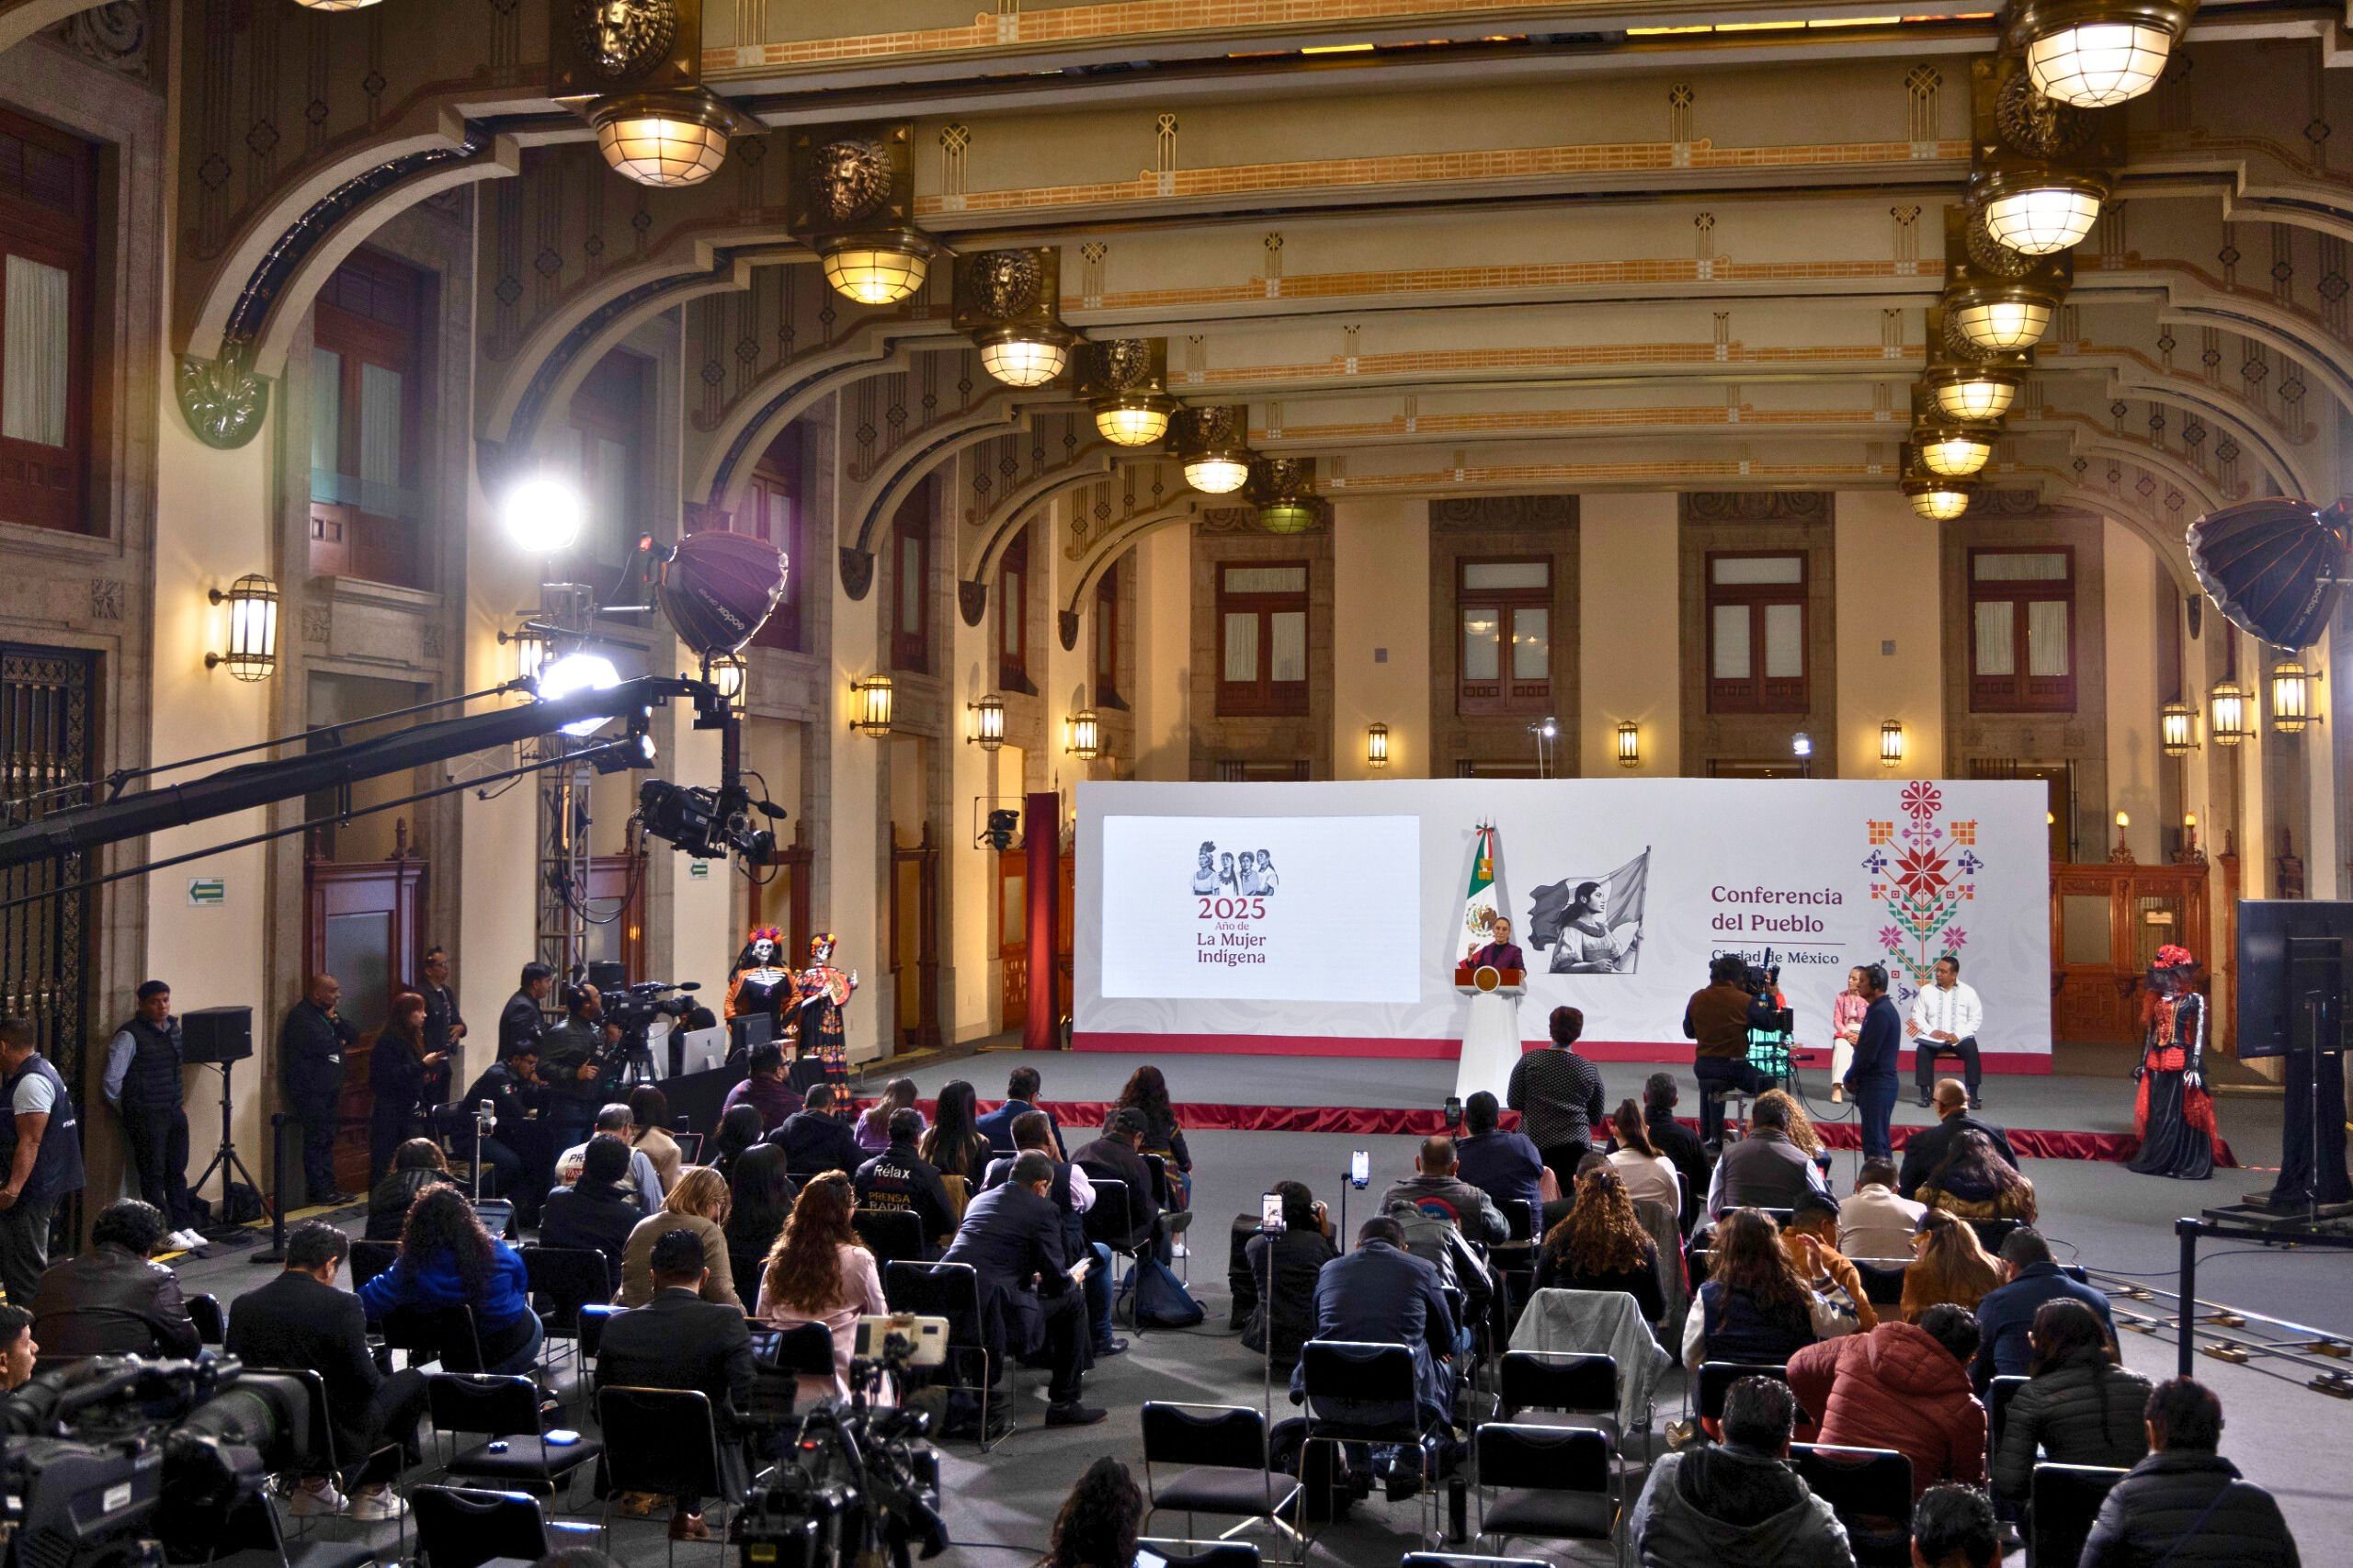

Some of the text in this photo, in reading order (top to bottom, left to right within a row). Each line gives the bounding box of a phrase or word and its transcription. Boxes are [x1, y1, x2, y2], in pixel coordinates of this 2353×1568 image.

[717, 605, 745, 631] Godox
[1711, 885, 1843, 905] Conferencia
[1198, 897, 1266, 920] 2025
[1215, 921, 1250, 931] Año de
[1711, 913, 1824, 933] del Pueblo
[1197, 932, 1267, 950] La Mujer
[1198, 949, 1266, 968] Indígena
[1788, 951, 1840, 964] México
[568, 1153, 585, 1164] PR
[873, 1163, 911, 1179] Rélax
[869, 1191, 911, 1204] PRENSA
[870, 1200, 912, 1211] RADIO
